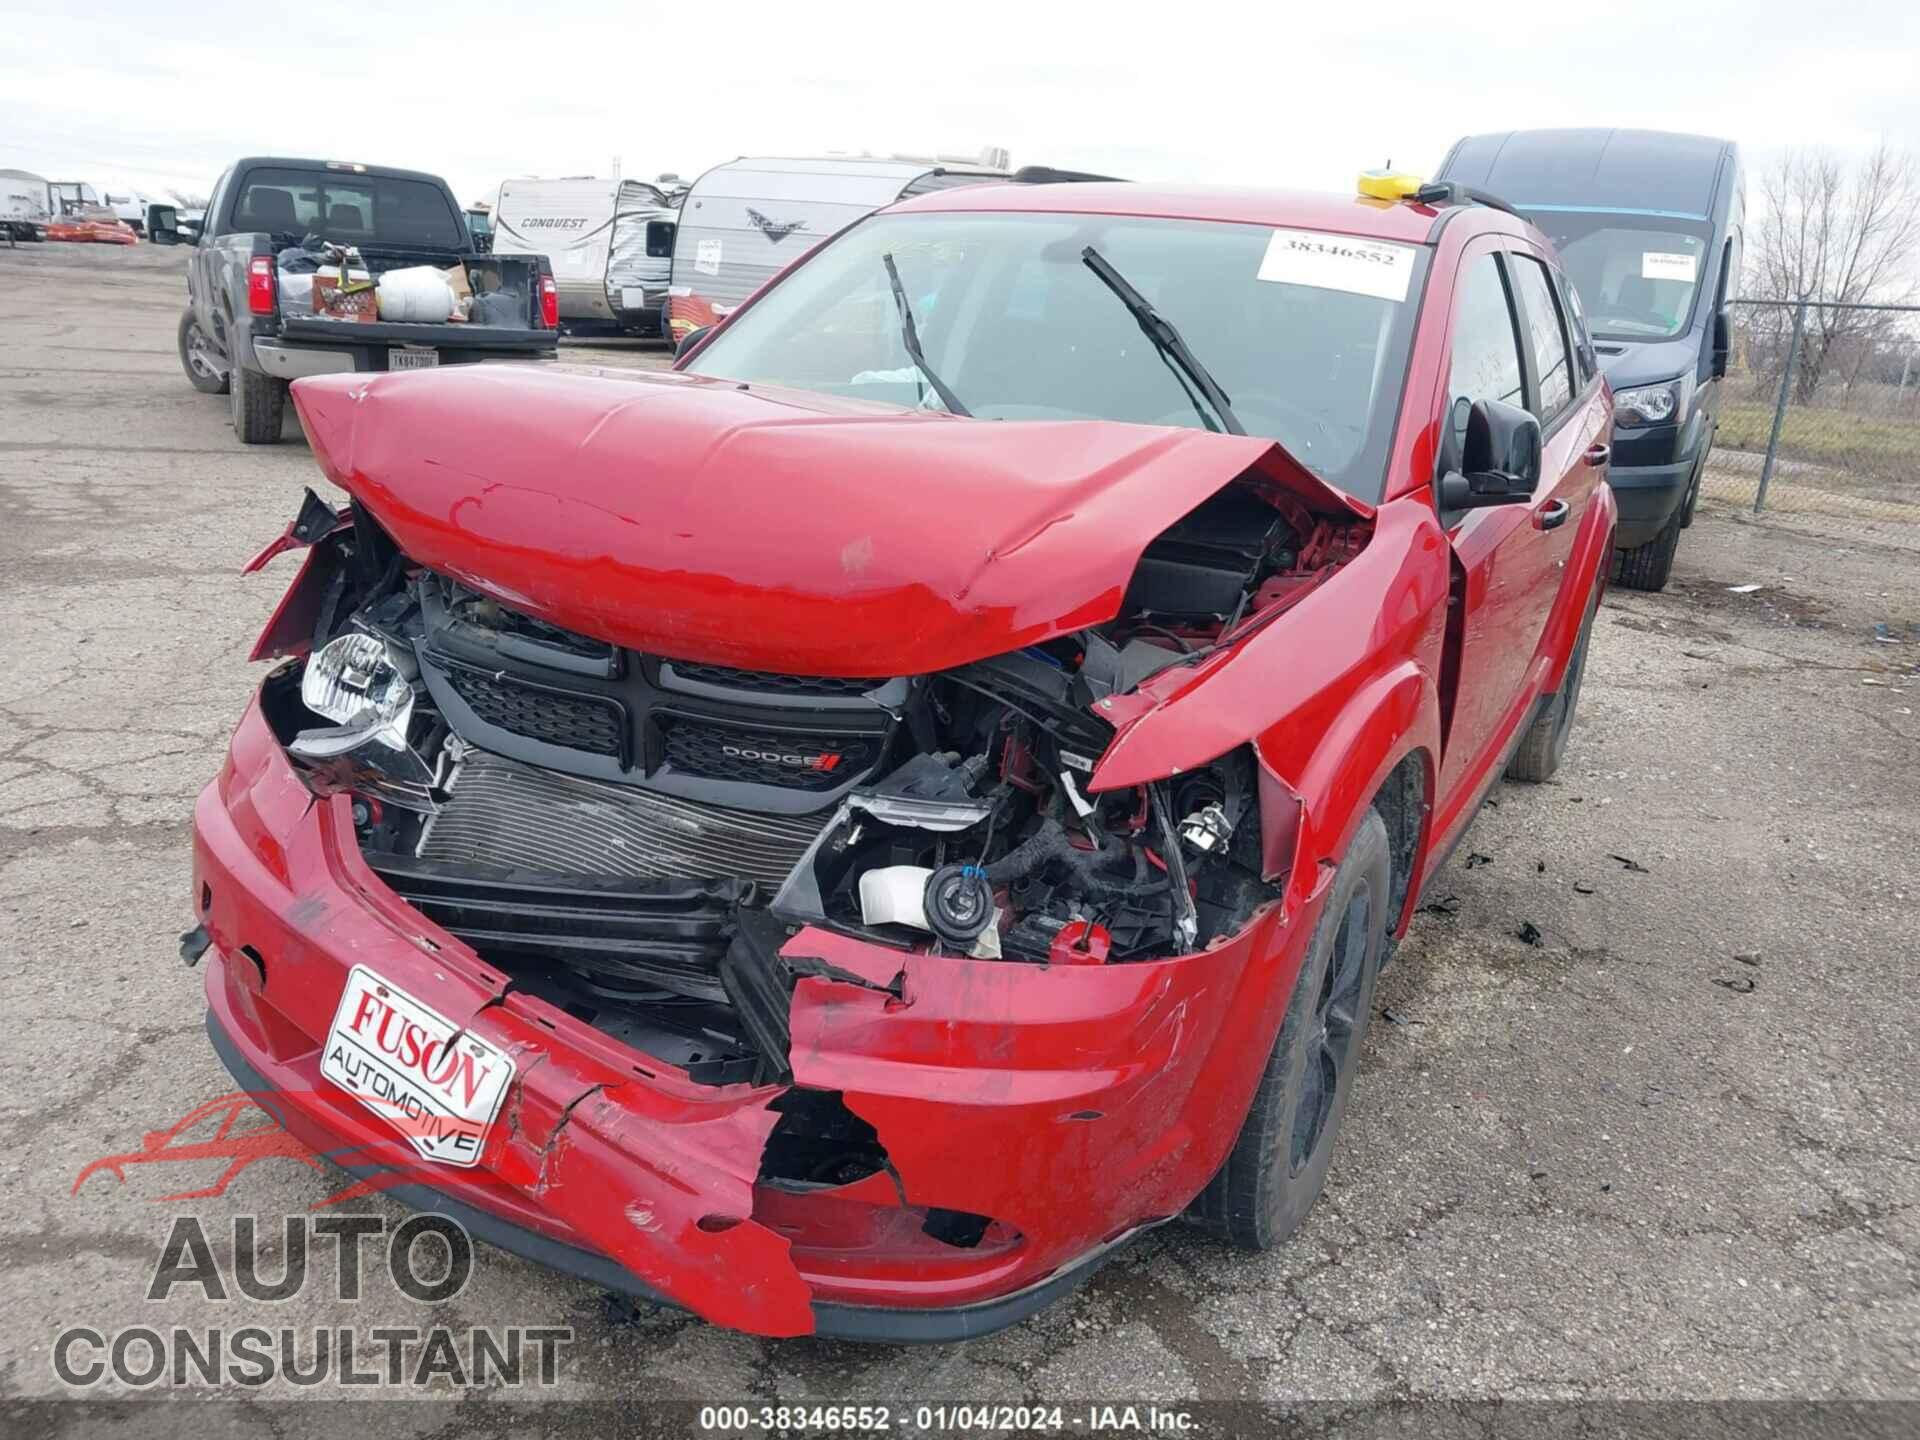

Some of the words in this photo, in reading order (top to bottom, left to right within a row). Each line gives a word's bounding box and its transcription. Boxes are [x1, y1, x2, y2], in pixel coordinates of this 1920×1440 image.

[520, 217, 589, 229] CONQUEST
[1287, 240, 1396, 266] 38346552
[722, 745, 825, 768] DODGE
[349, 989, 492, 1109] FUSON
[329, 1045, 479, 1152] AUTOMOTIVE
